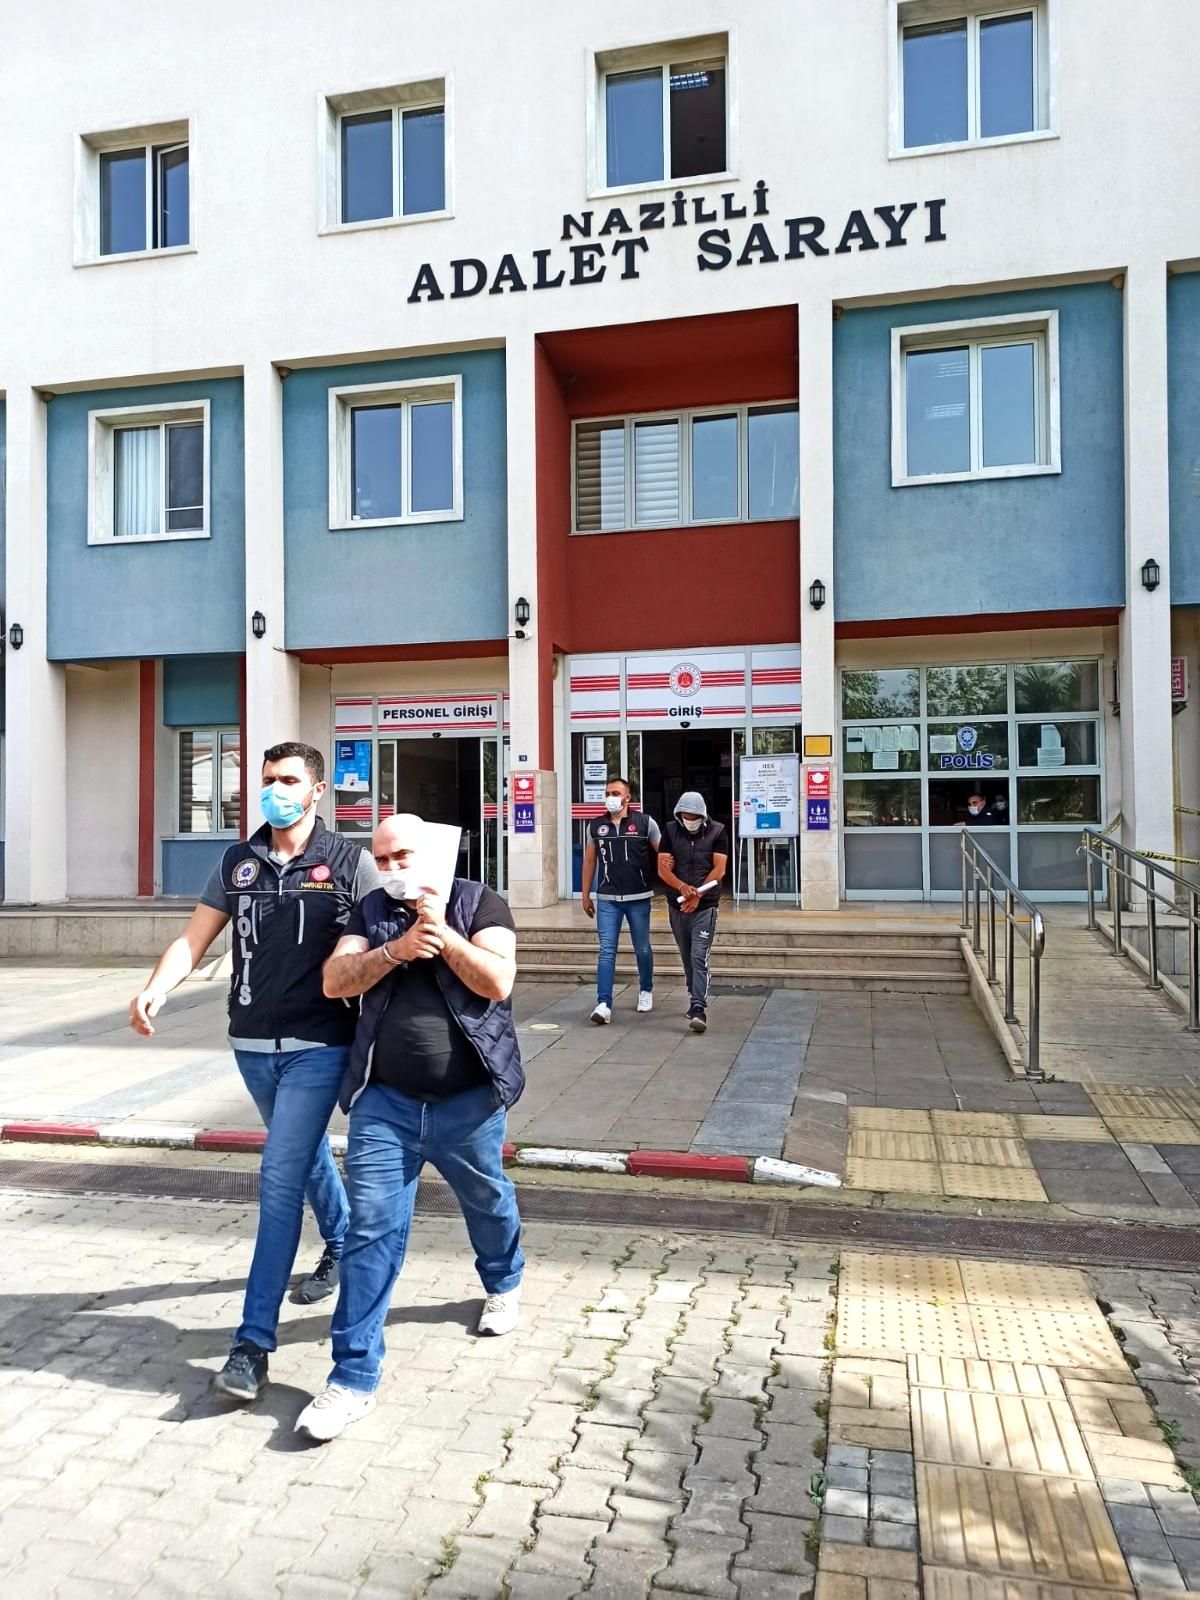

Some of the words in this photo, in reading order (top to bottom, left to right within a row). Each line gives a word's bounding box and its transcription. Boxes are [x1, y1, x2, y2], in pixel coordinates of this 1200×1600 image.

[560, 180, 770, 240] NAZİLLİ
[407, 236, 648, 303] ADALET
[697, 198, 946, 271] SARAYI
[383, 707, 450, 719] PERSONEL
[453, 703, 493, 719] GİRİŞİ
[669, 705, 703, 719] GİRİŞ
[940, 750, 994, 769] POLİS
